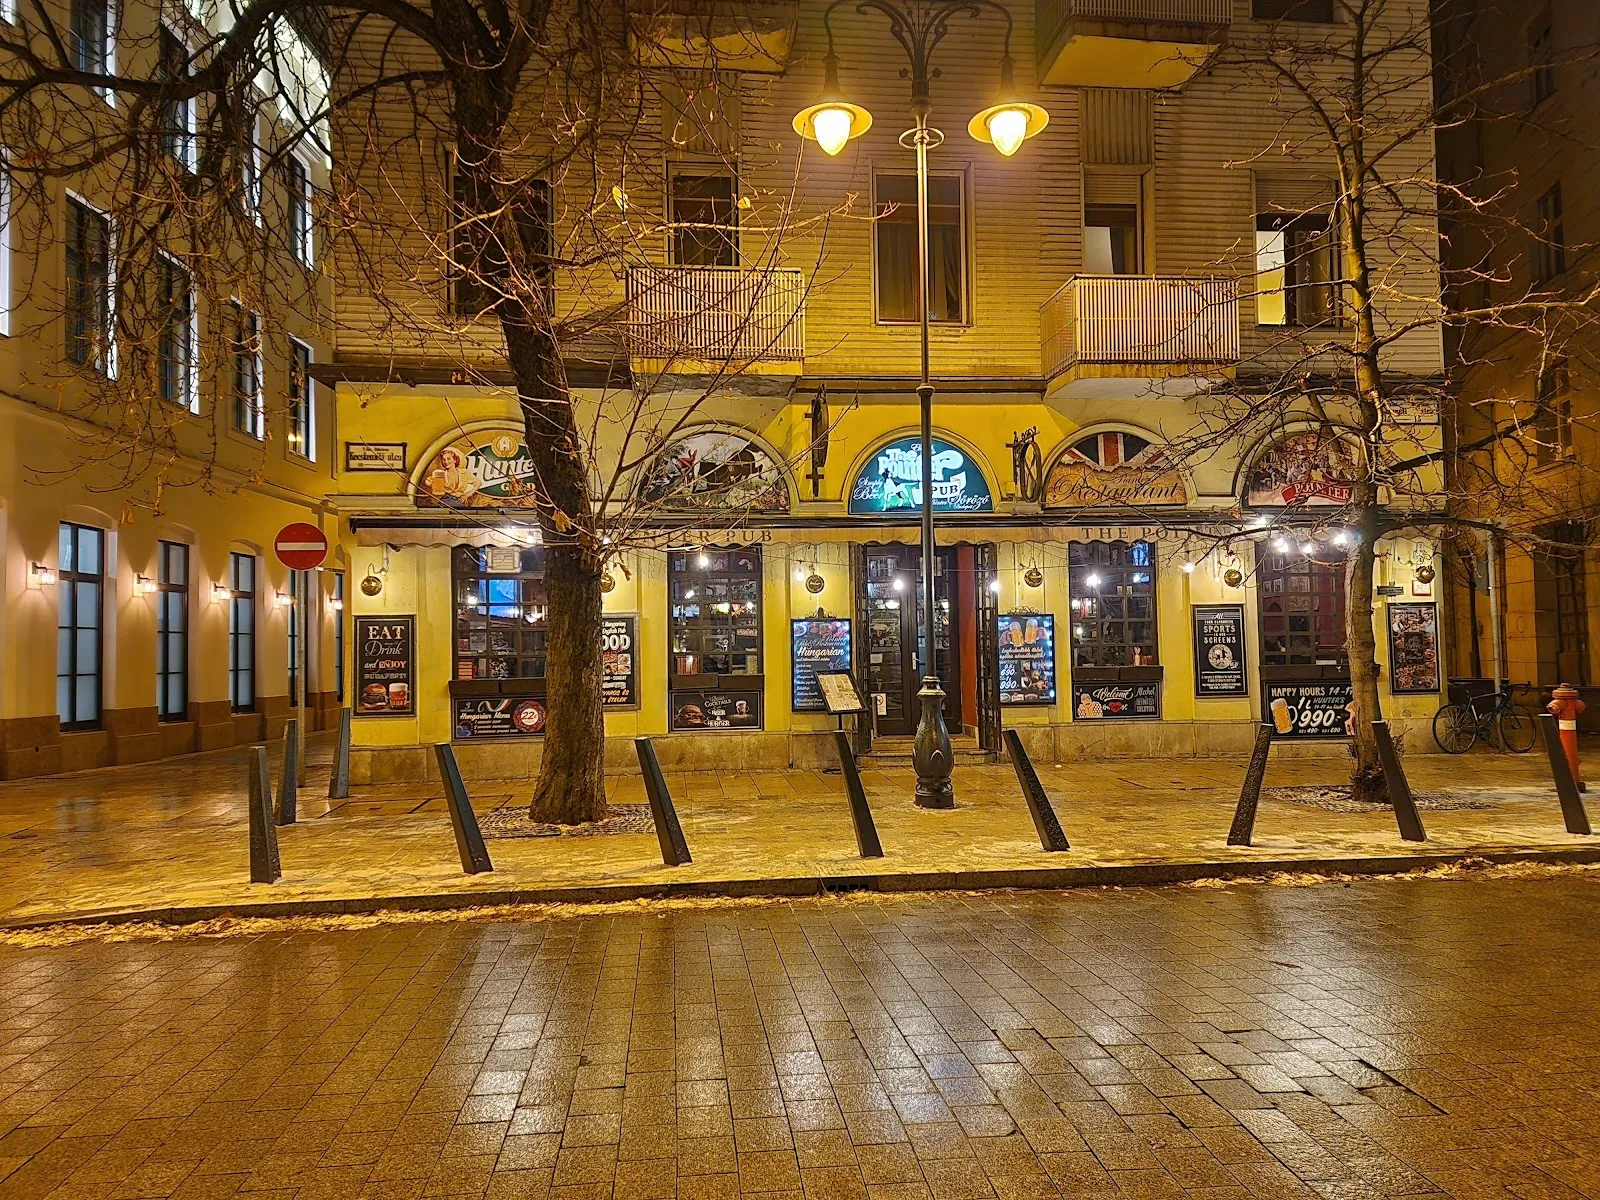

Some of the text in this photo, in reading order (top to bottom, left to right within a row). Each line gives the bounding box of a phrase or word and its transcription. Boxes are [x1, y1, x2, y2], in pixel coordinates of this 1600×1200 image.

[886, 448, 917, 461] The
[466, 455, 535, 483] Hunte
[501, 483, 536, 491] GD
[1051, 474, 1180, 503] Restaurant
[726, 530, 772, 543] PUB
[1081, 528, 1129, 539] THE
[368, 626, 405, 639] EAT
[1203, 625, 1236, 633] SPORTS
[365, 640, 406, 656] Drink
[797, 647, 845, 658] Hungarian
[379, 660, 406, 669] ENJOY
[1092, 687, 1134, 701] Welcome
[1271, 687, 1297, 697] HAPPY
[1299, 687, 1326, 697] HOURS
